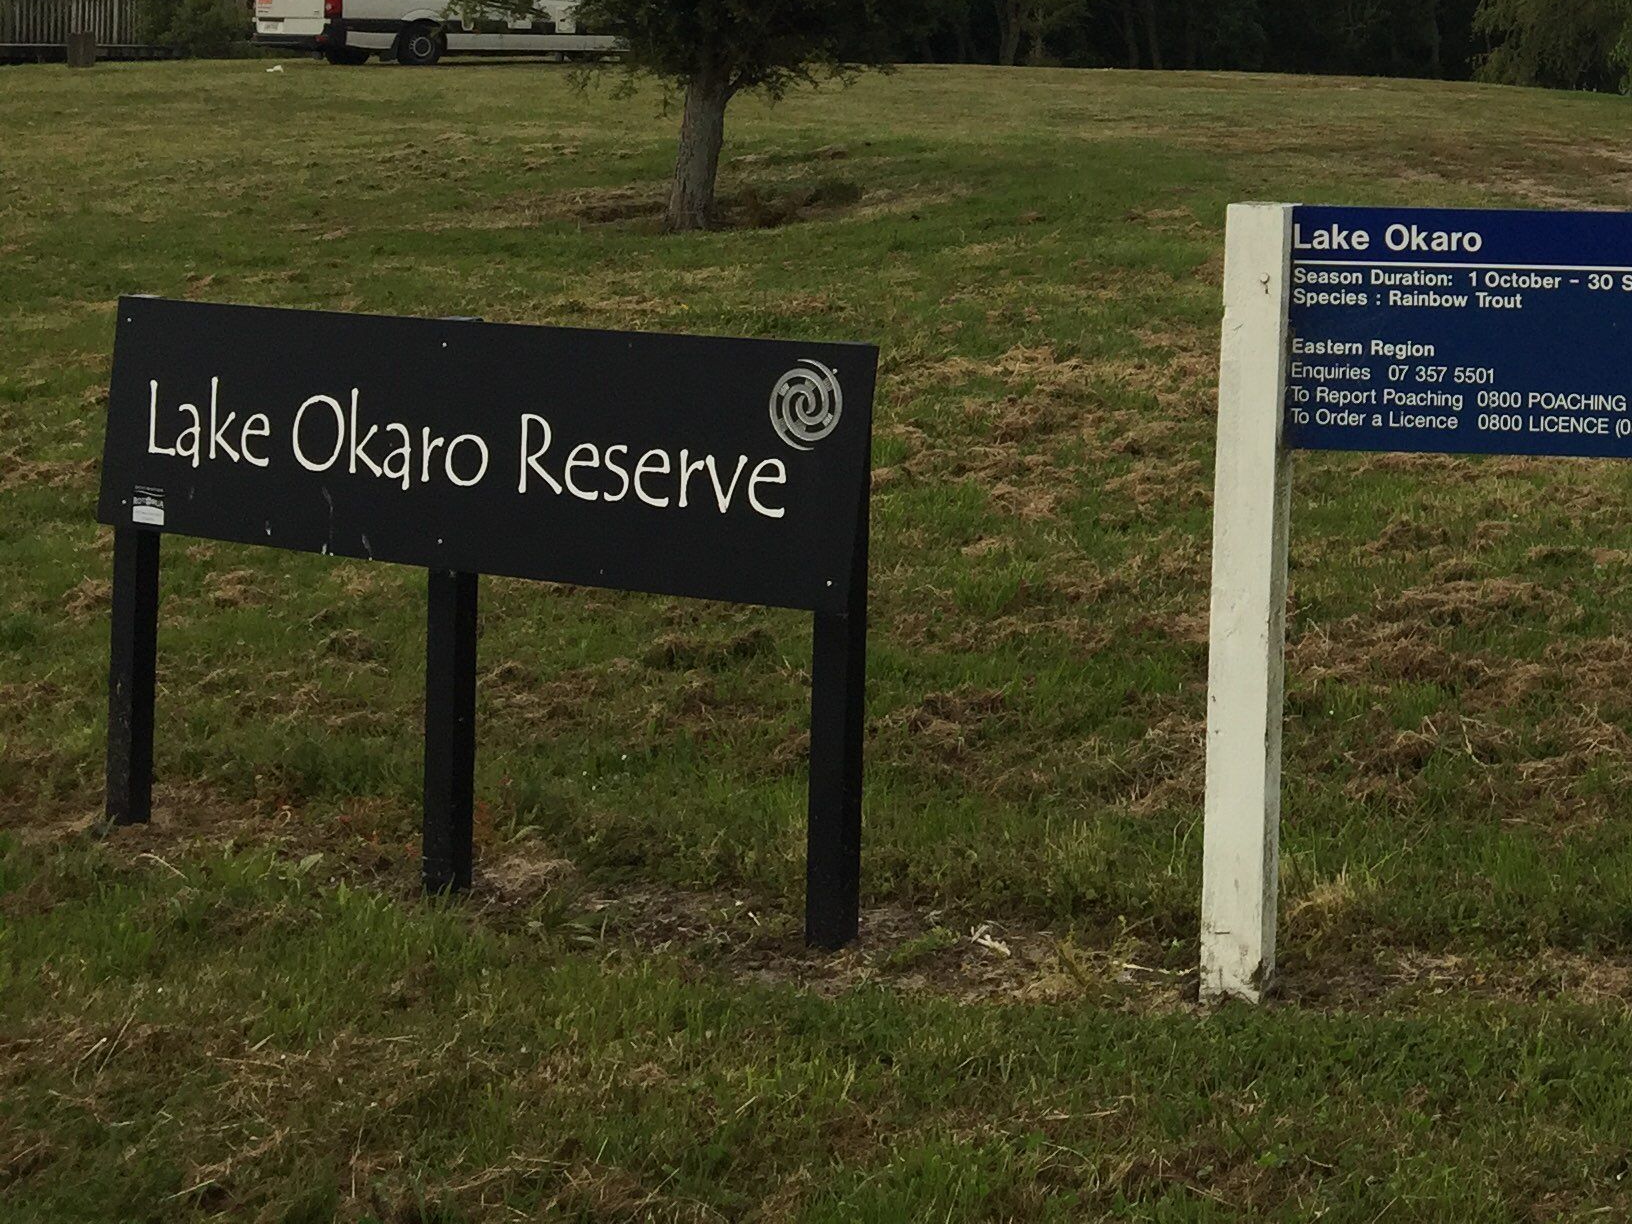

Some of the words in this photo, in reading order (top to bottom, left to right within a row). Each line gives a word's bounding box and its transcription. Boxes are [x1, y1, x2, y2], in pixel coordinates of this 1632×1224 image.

[1293, 223, 1370, 251] Lake
[1385, 223, 1483, 252] Okaro
[1293, 268, 1363, 285] Season
[1370, 269, 1453, 287] Duration:
[1469, 271, 1477, 287] 1
[1485, 271, 1562, 289] October
[1587, 274, 1614, 291] 30
[1293, 288, 1368, 308] Species
[1389, 290, 1468, 308] Rainbow
[1475, 292, 1523, 309] Trout
[1292, 338, 1363, 355] Eastern
[1370, 339, 1435, 360] Region
[1291, 362, 1371, 380] Enquiries
[1388, 365, 1409, 381] 07
[1415, 366, 1448, 383] 357
[1453, 367, 1495, 384] 5501
[1290, 385, 1310, 402] To
[1316, 386, 1376, 407] Report
[1383, 389, 1463, 411] Poaching
[1477, 391, 1522, 408] 0800
[1528, 392, 1627, 412] POACHING
[1290, 408, 1310, 424] To
[1315, 408, 1366, 426] Order
[1372, 414, 1383, 427] a
[1389, 410, 1459, 429] Licence
[1477, 414, 1522, 431] 0800
[1529, 415, 1609, 434] LICENCE
[147, 376, 271, 469] Lake
[291, 388, 489, 491] Okaro
[517, 412, 787, 519] Reserve
